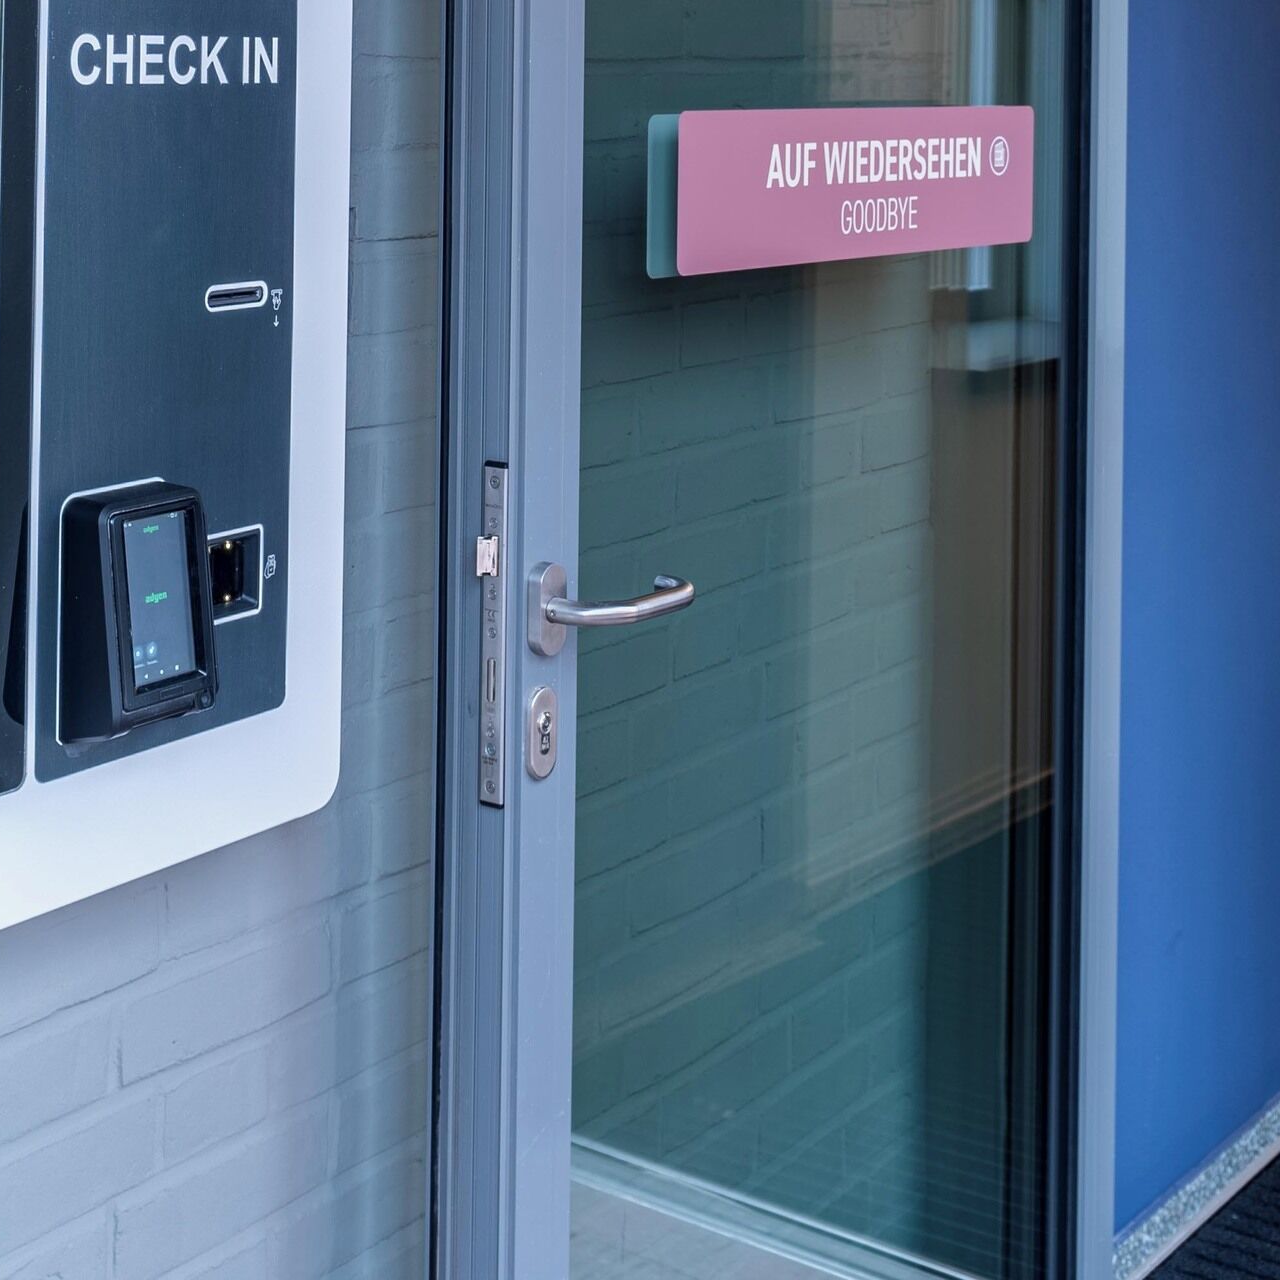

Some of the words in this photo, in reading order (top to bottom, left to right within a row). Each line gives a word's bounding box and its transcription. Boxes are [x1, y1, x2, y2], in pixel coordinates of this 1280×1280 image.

[70, 33, 230, 86] CHECK
[241, 36, 280, 84] IN
[766, 142, 817, 188] AUF
[823, 137, 982, 186] WIEDERSEHEN
[840, 196, 919, 234] GOODBYE
